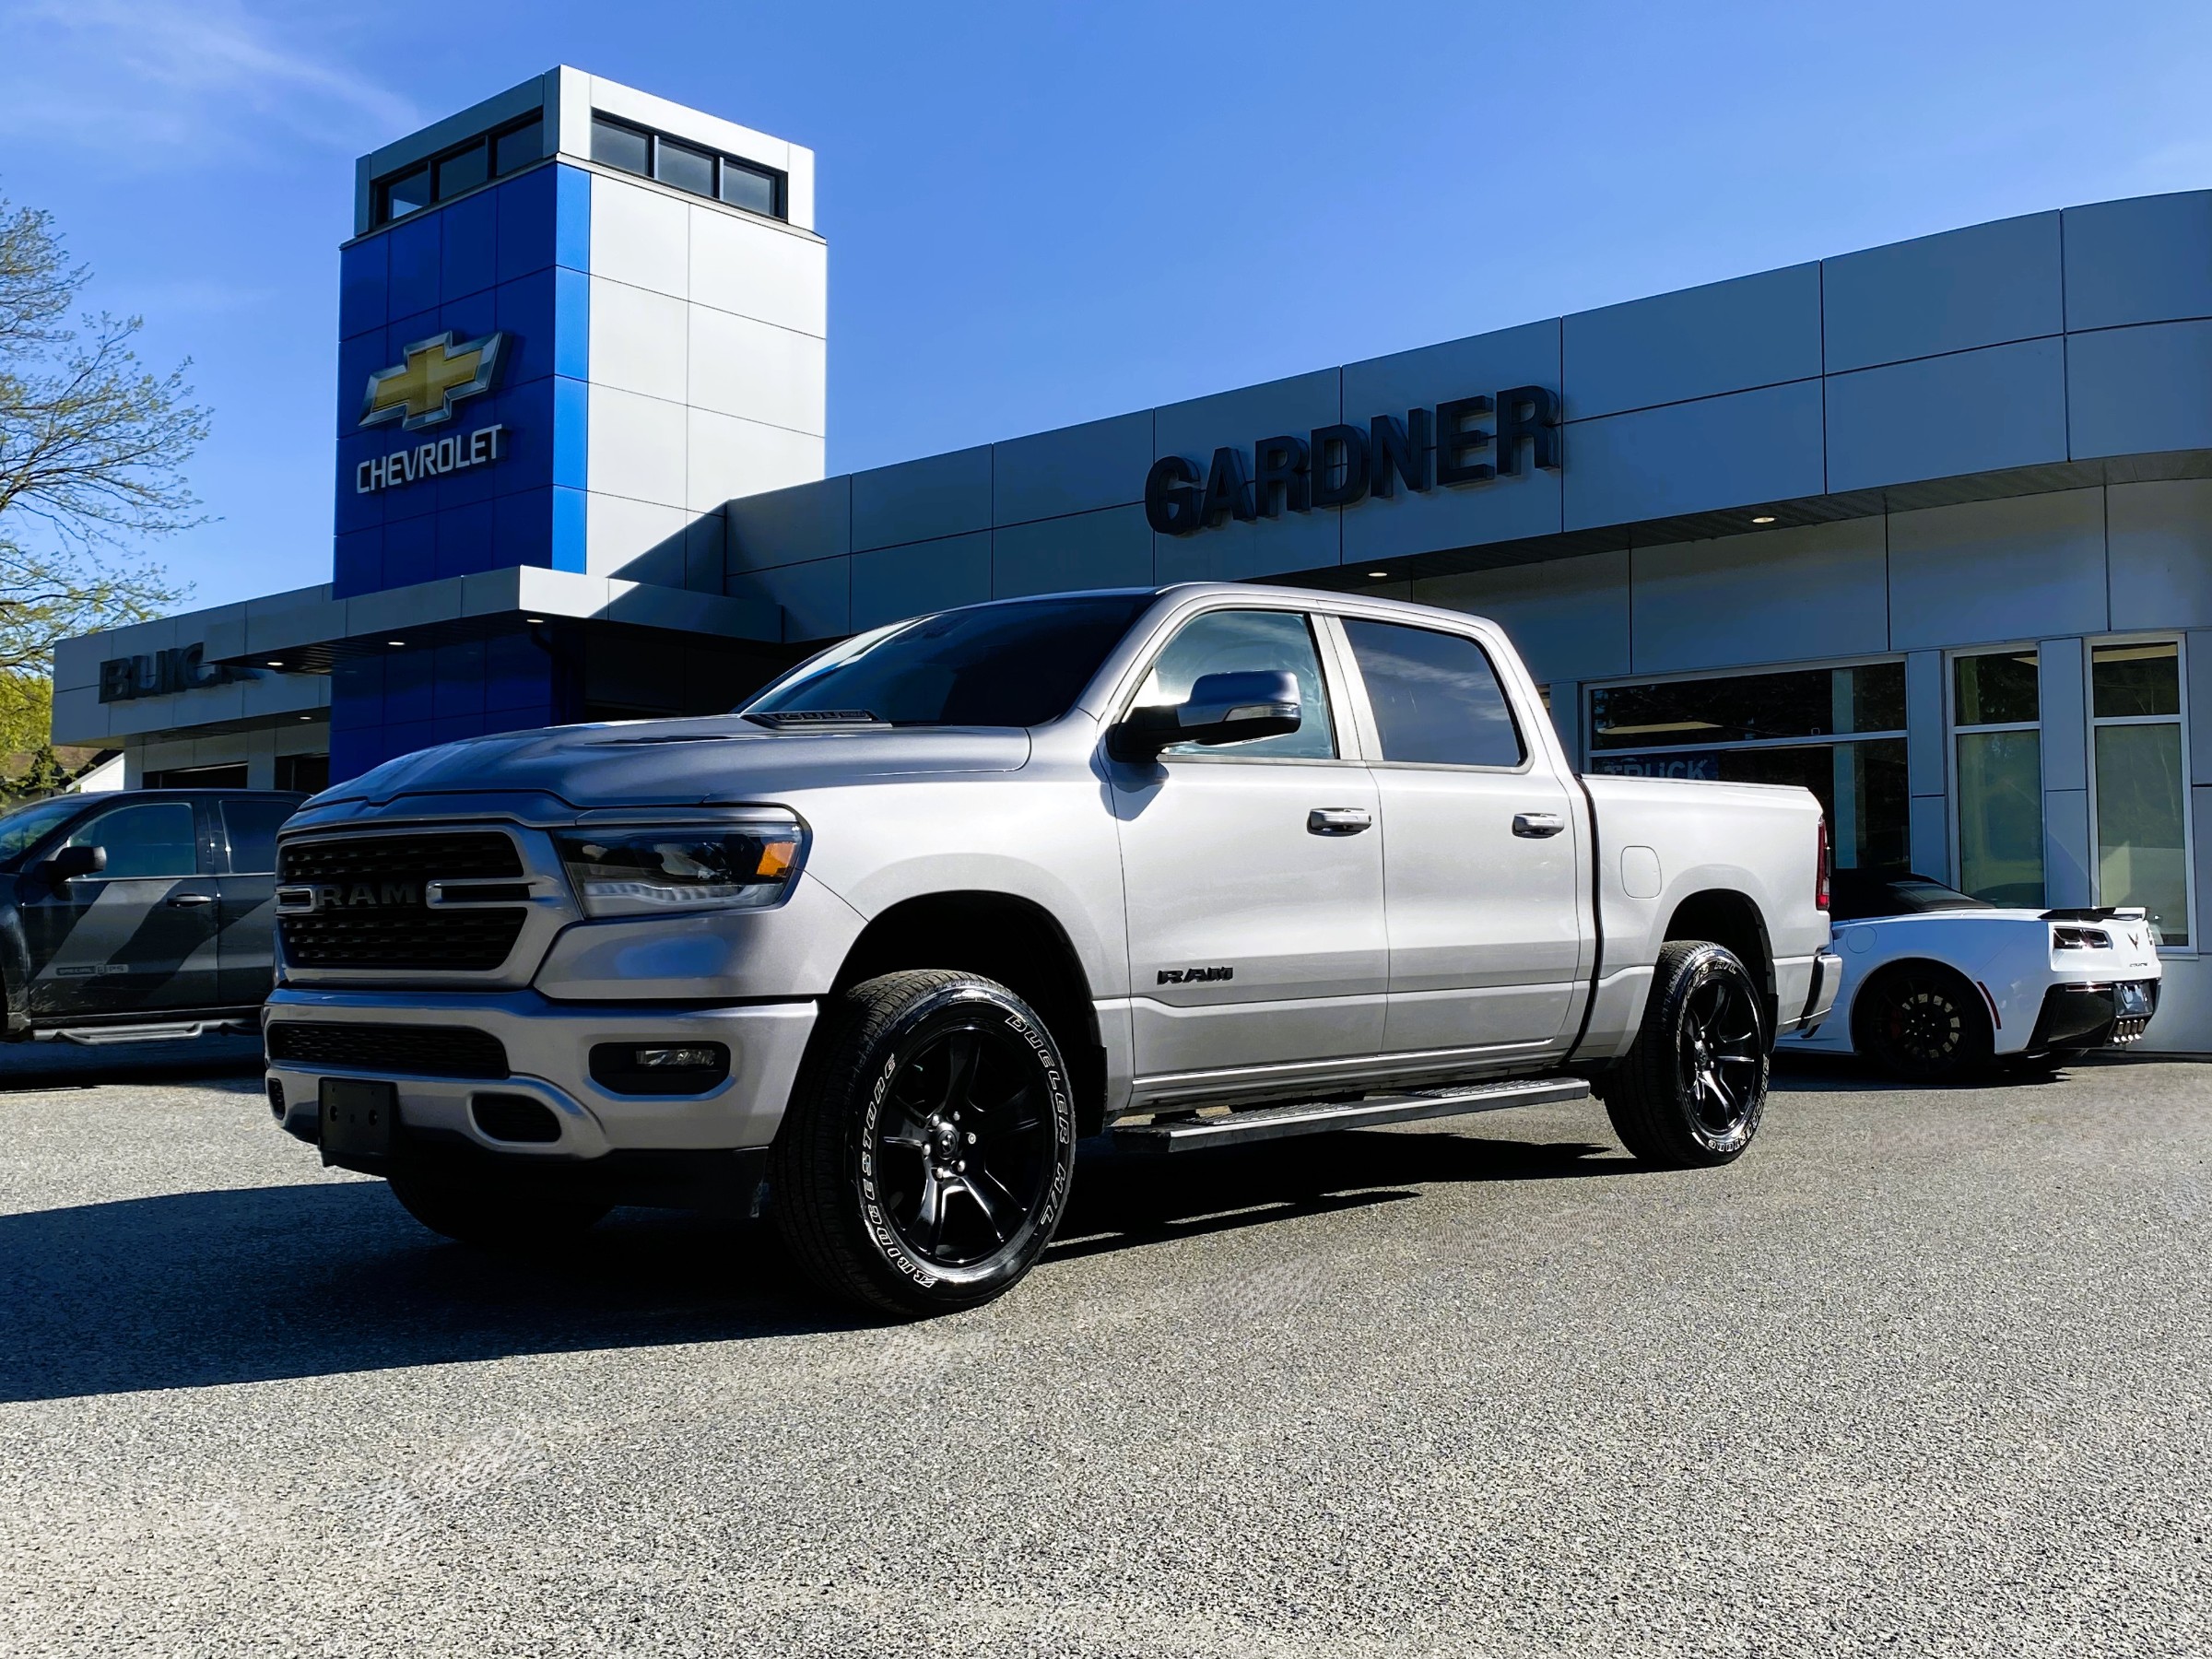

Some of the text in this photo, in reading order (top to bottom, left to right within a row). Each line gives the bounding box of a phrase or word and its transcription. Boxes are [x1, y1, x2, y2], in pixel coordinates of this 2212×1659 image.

[357, 424, 502, 494] CHEVROLET
[1145, 384, 1559, 536] GARDNER
[316, 882, 418, 906] RAM
[1156, 966, 1233, 986] RAM
[1005, 1015, 1070, 1145] DUELER
[862, 1053, 939, 1288] BRIDGESTONE
